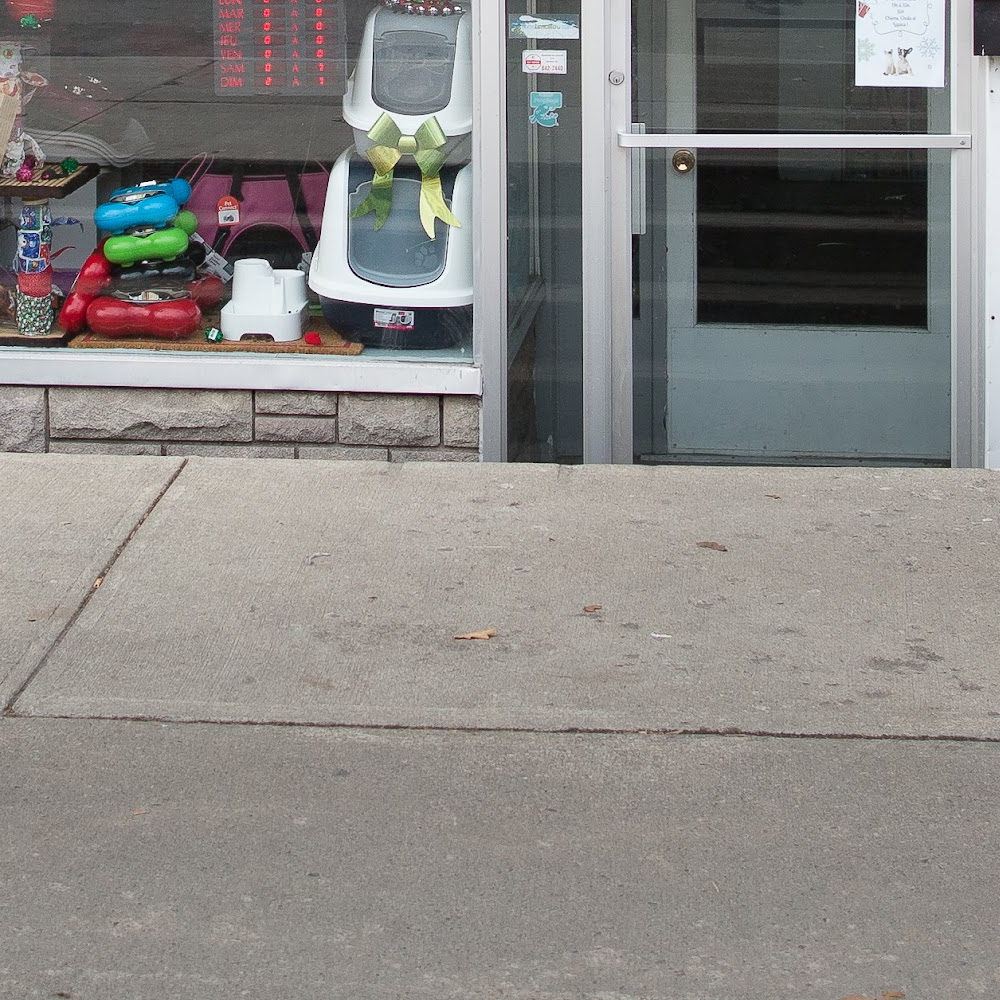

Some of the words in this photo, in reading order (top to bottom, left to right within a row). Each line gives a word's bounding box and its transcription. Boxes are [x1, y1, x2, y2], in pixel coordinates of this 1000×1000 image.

[219, 8, 244, 19] MAR
[219, 22, 241, 33] MER
[220, 49, 242, 60] VEN
[221, 64, 245, 73] SAM
[220, 76, 243, 87] DIM
